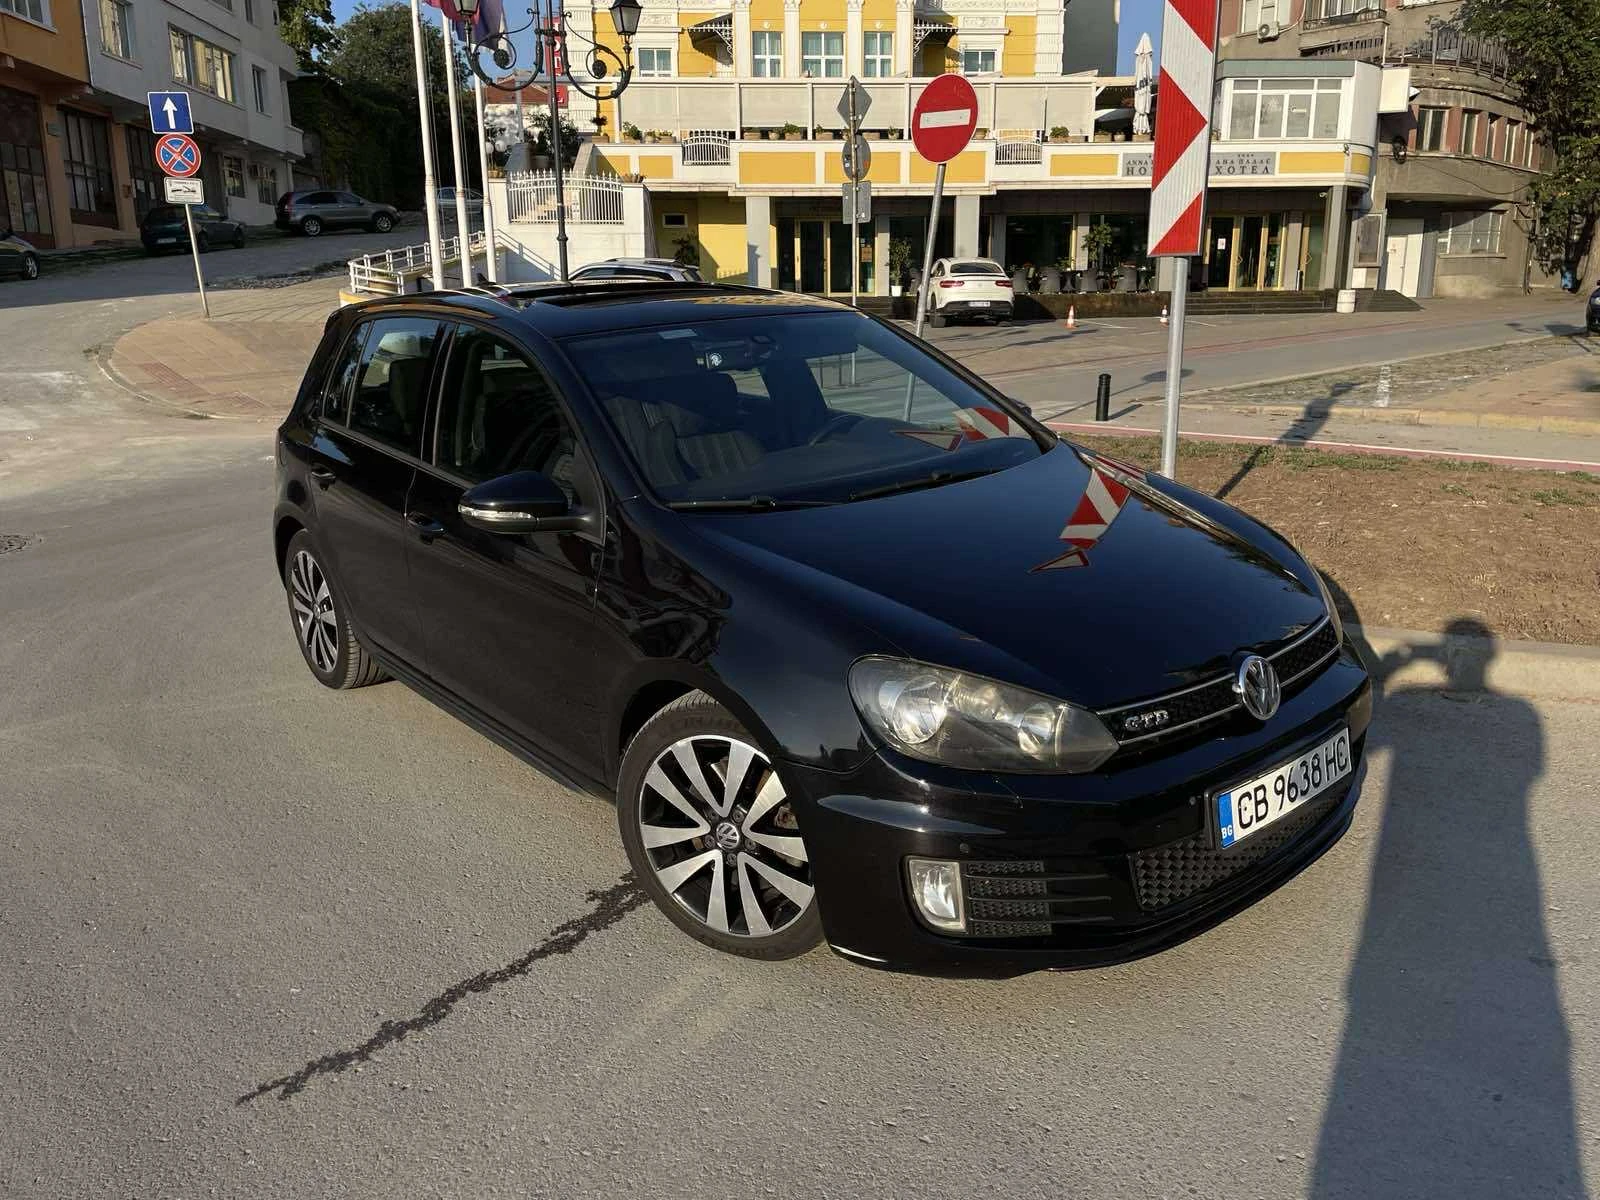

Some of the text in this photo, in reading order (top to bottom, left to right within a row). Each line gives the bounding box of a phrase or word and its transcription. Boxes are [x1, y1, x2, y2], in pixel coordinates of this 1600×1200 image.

[1215, 165, 1270, 175] ХОТЕЛ
[1237, 783, 1269, 830] CB
[1273, 753, 1322, 812] 9638
[1221, 824, 1233, 839] BG
